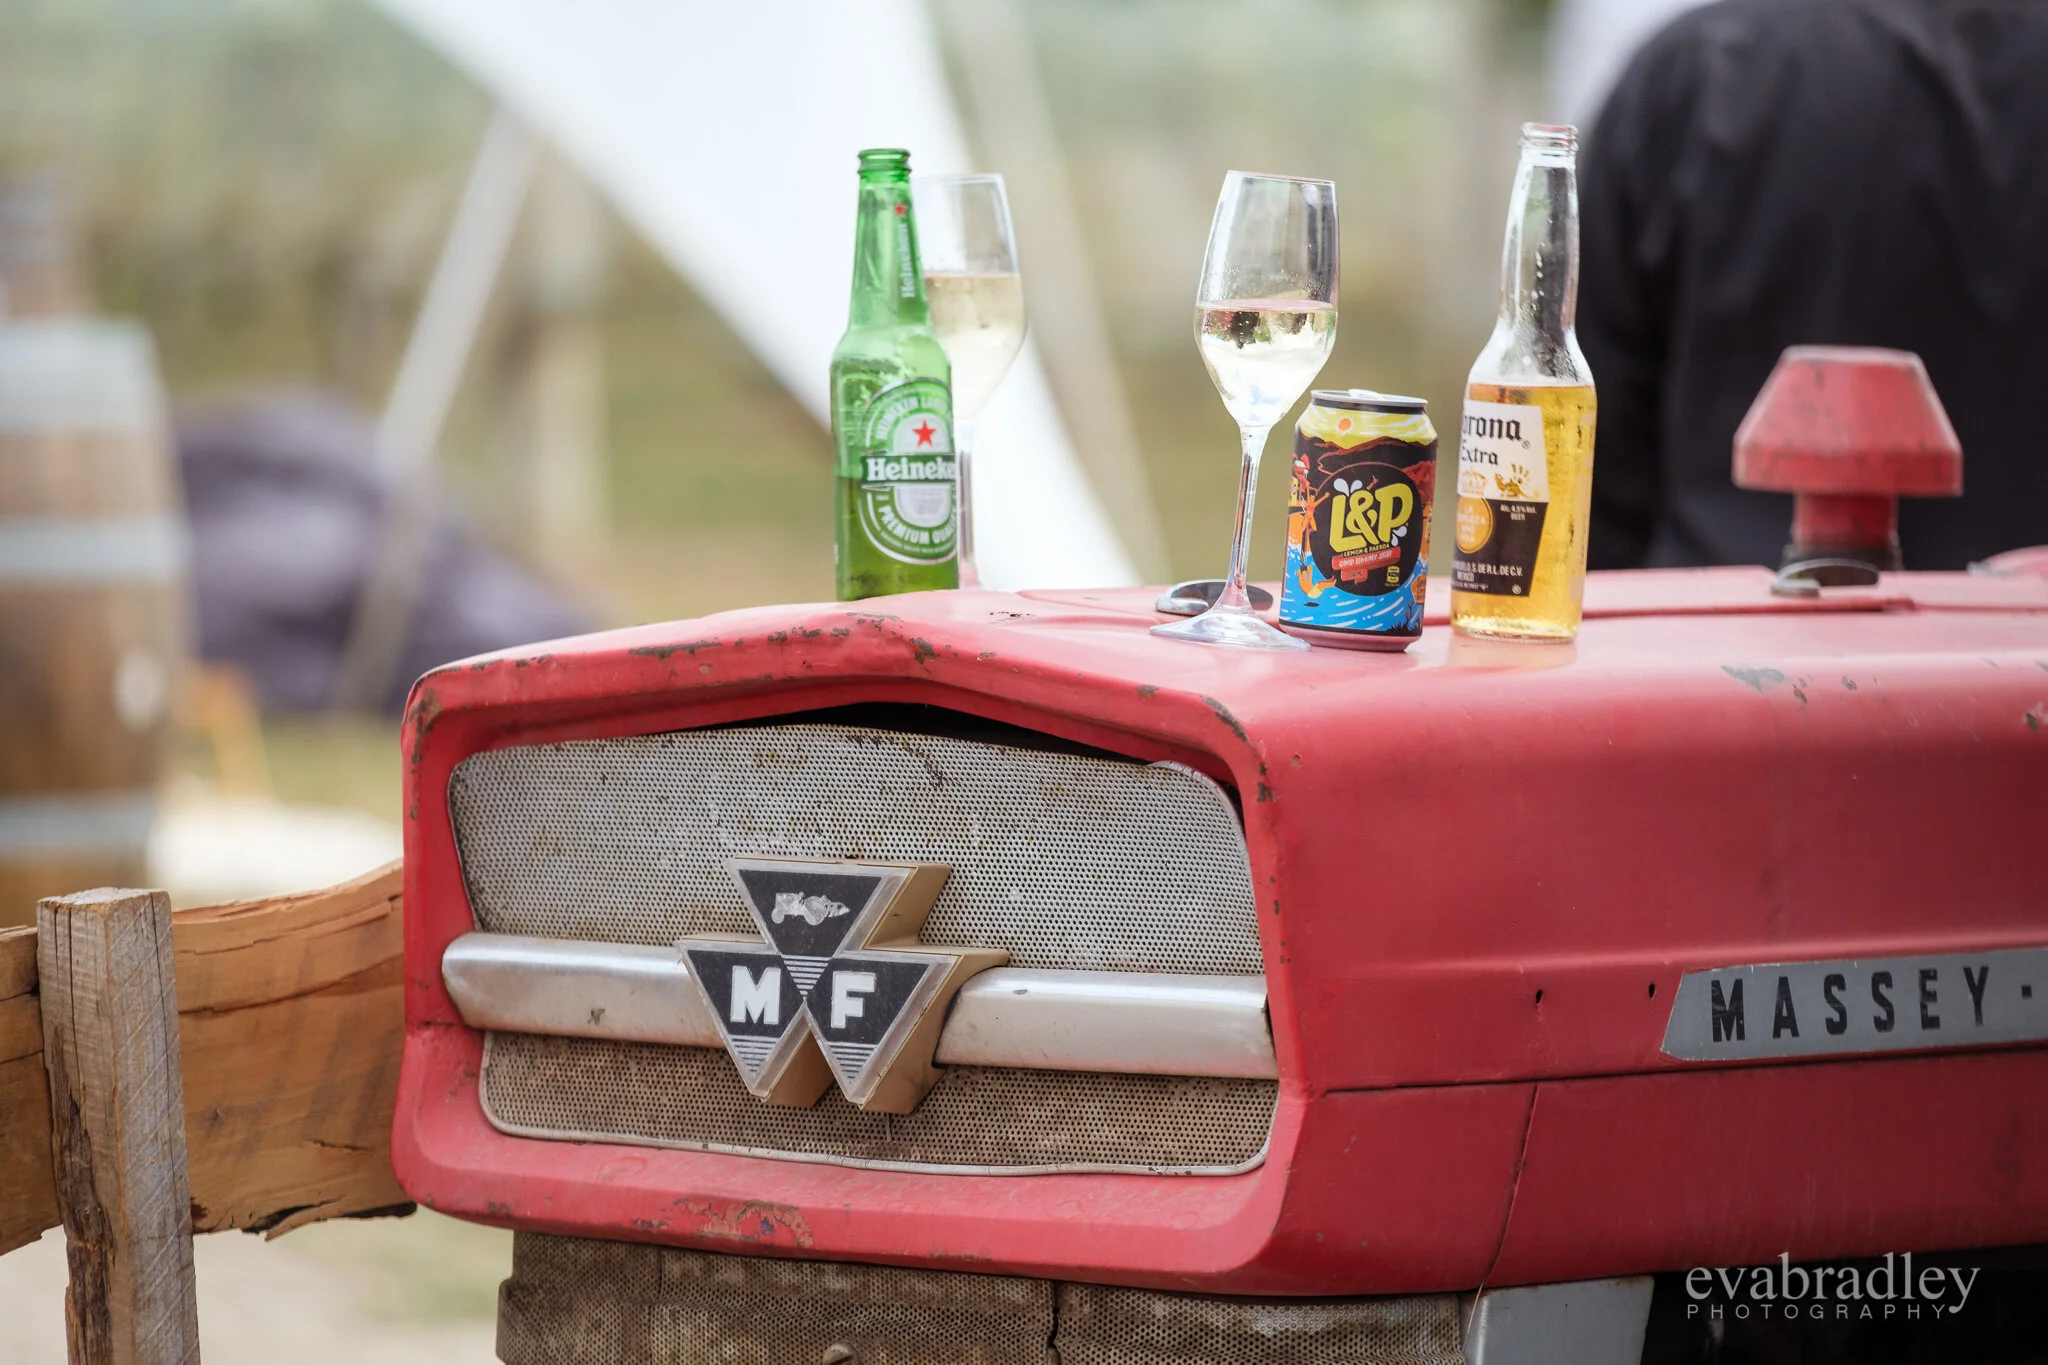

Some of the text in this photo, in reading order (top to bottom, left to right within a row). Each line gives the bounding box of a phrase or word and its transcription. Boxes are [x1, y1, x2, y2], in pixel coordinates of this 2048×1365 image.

[1463, 416, 1522, 441] orona
[867, 456, 957, 481] Heineke
[878, 505, 930, 545] PREMIUM
[1329, 482, 1414, 553] L&P
[1343, 549, 1363, 557] LEMON
[730, 965, 877, 1029] M F
